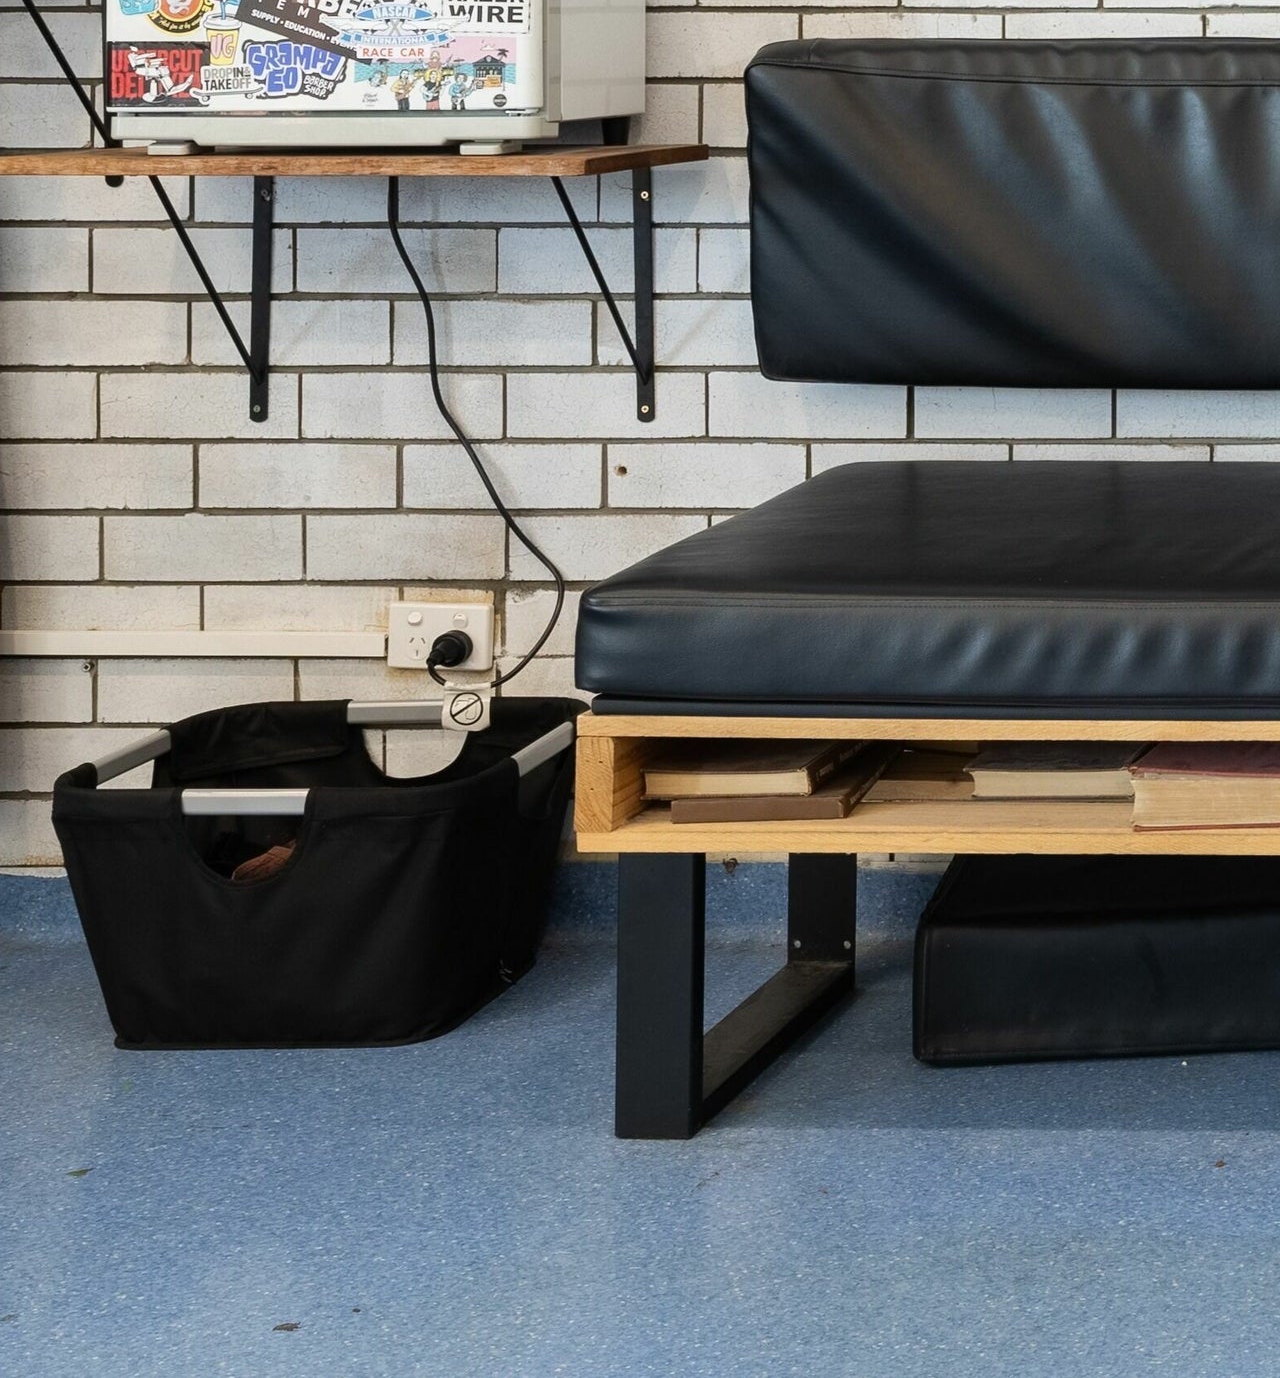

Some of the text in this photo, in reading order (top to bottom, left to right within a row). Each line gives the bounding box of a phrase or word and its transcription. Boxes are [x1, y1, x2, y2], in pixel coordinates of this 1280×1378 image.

[373, 3, 417, 18] NASCAR
[448, 4, 524, 24] WIRE
[250, 8, 281, 25] SUPPLY
[283, 20, 327, 42] EDUCATION
[362, 47, 425, 57] RACE CAR
